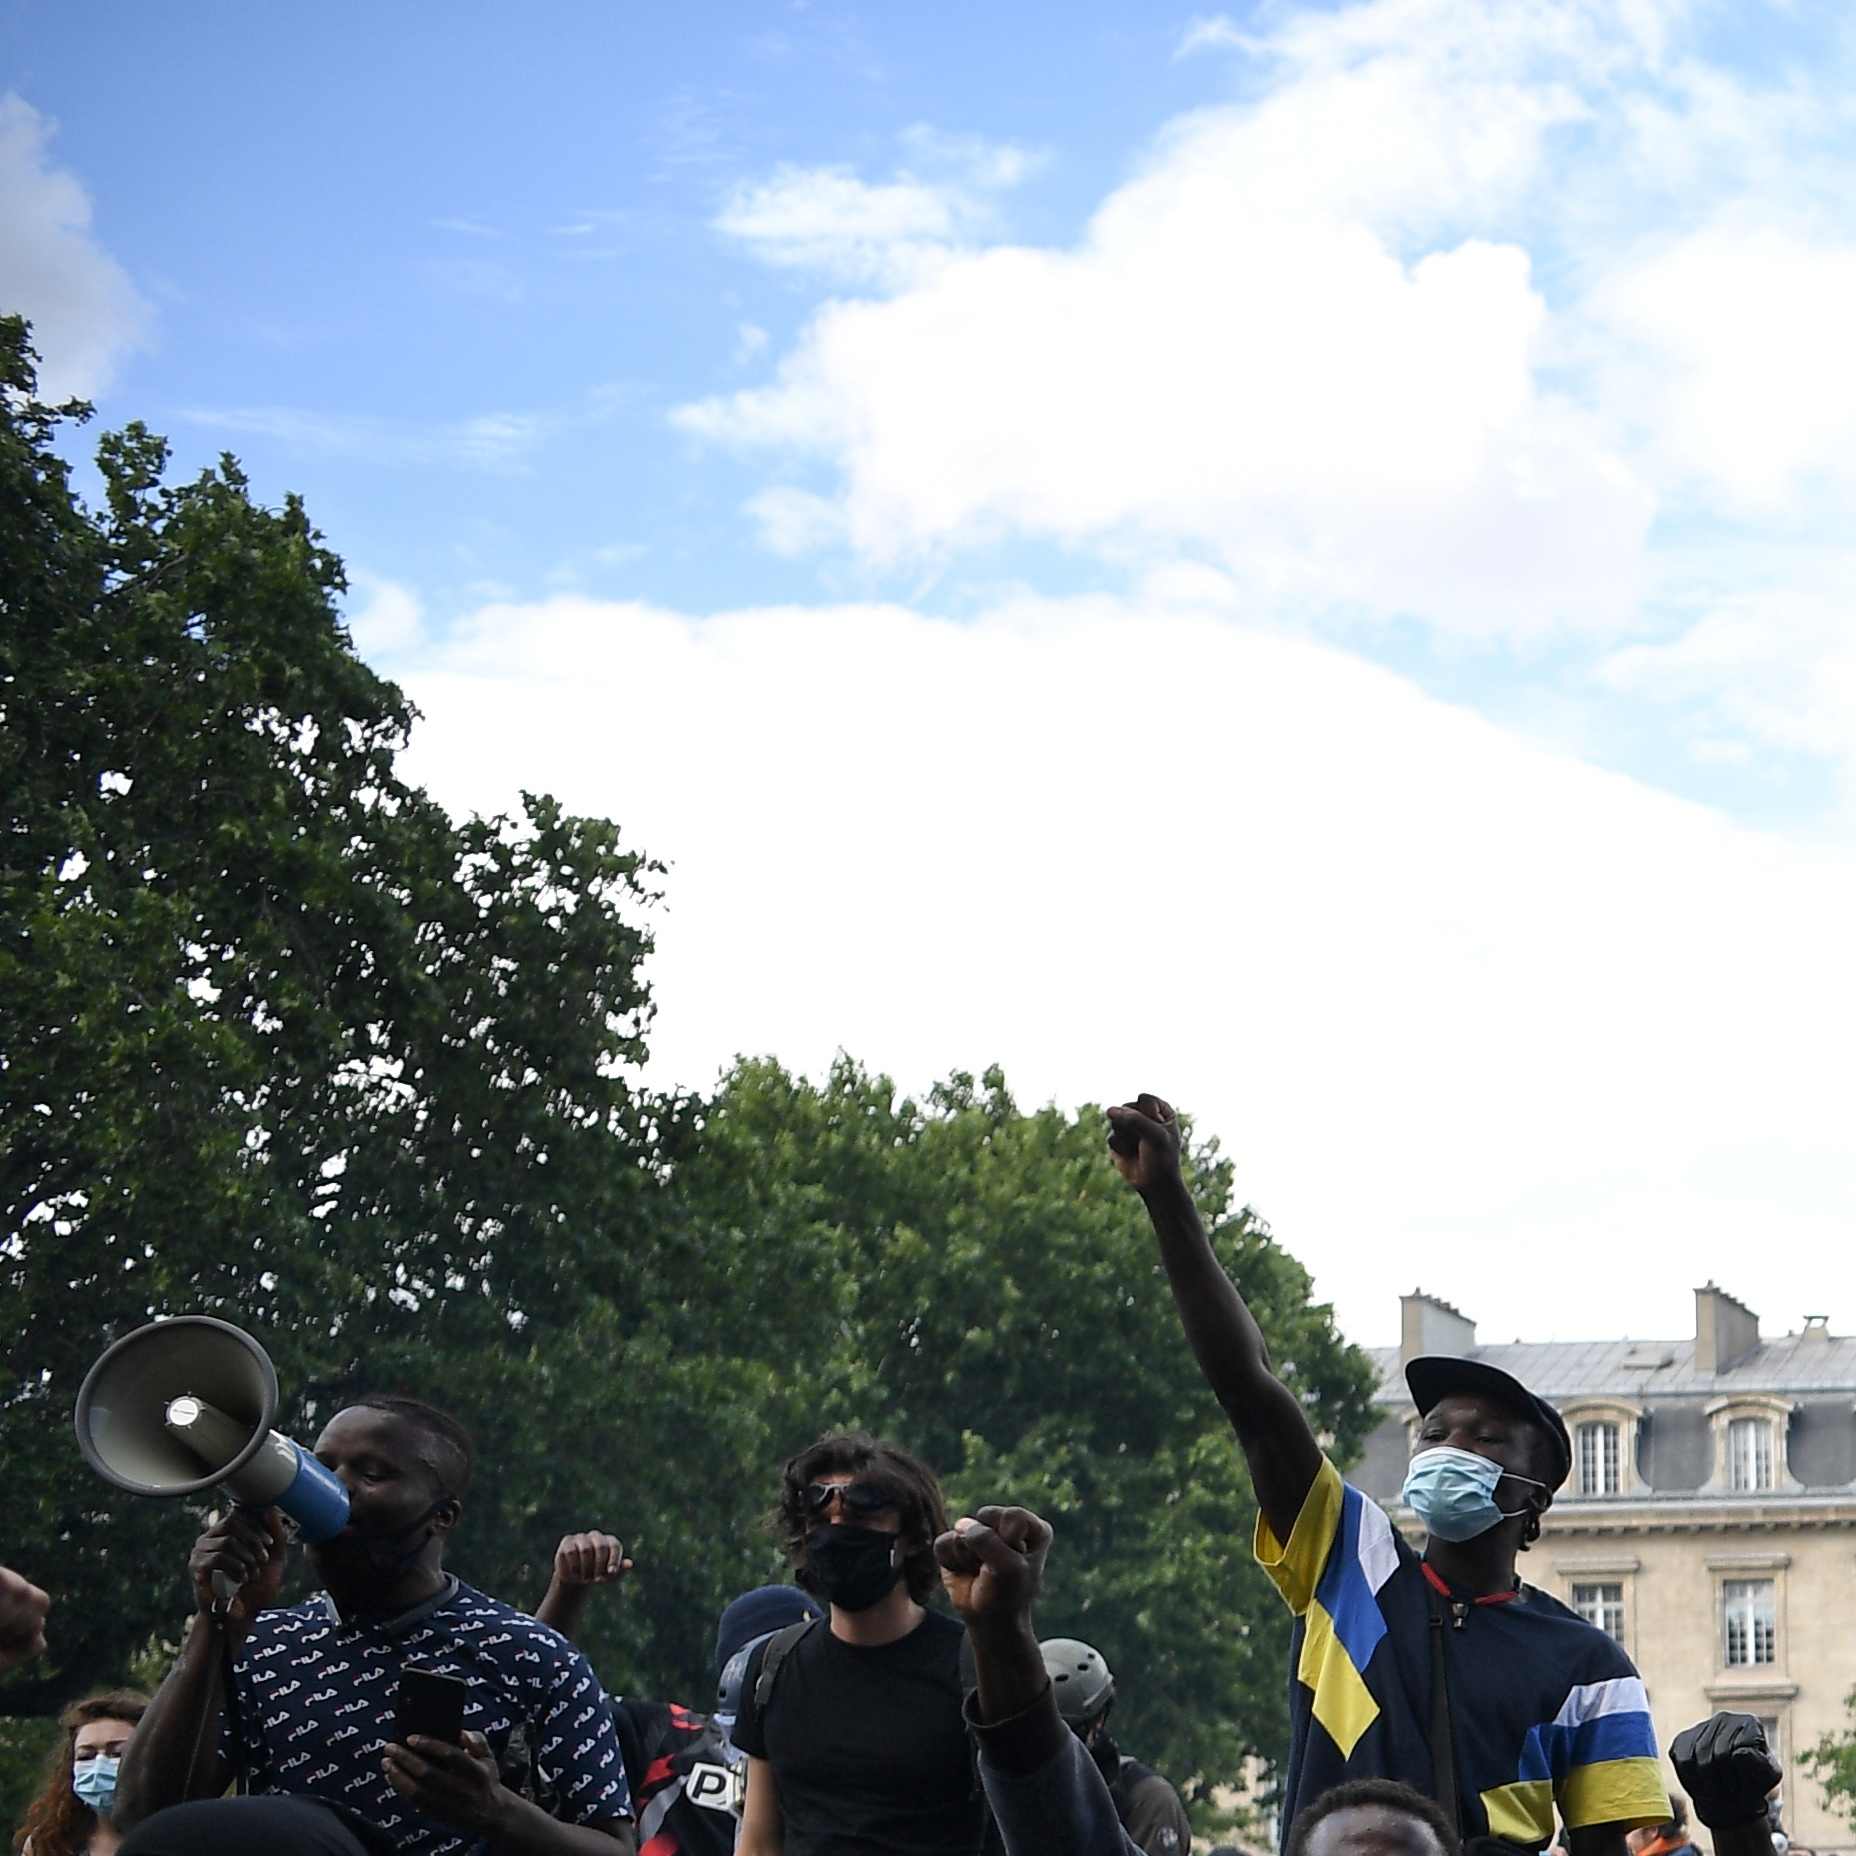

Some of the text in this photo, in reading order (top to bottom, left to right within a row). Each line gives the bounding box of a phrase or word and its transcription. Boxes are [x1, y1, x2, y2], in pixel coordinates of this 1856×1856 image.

[317, 1660, 350, 1680] FILA
[352, 1666, 385, 1687] FILA
[268, 1679, 301, 1700] FILA
[304, 1688, 339, 1707] FILA
[334, 1699, 369, 1717] FILA
[287, 1719, 319, 1742] FILA
[325, 1725, 360, 1747] FILA
[279, 1751, 312, 1774] FILA
[305, 1762, 340, 1785] FILA
[344, 1770, 377, 1792] FILA
